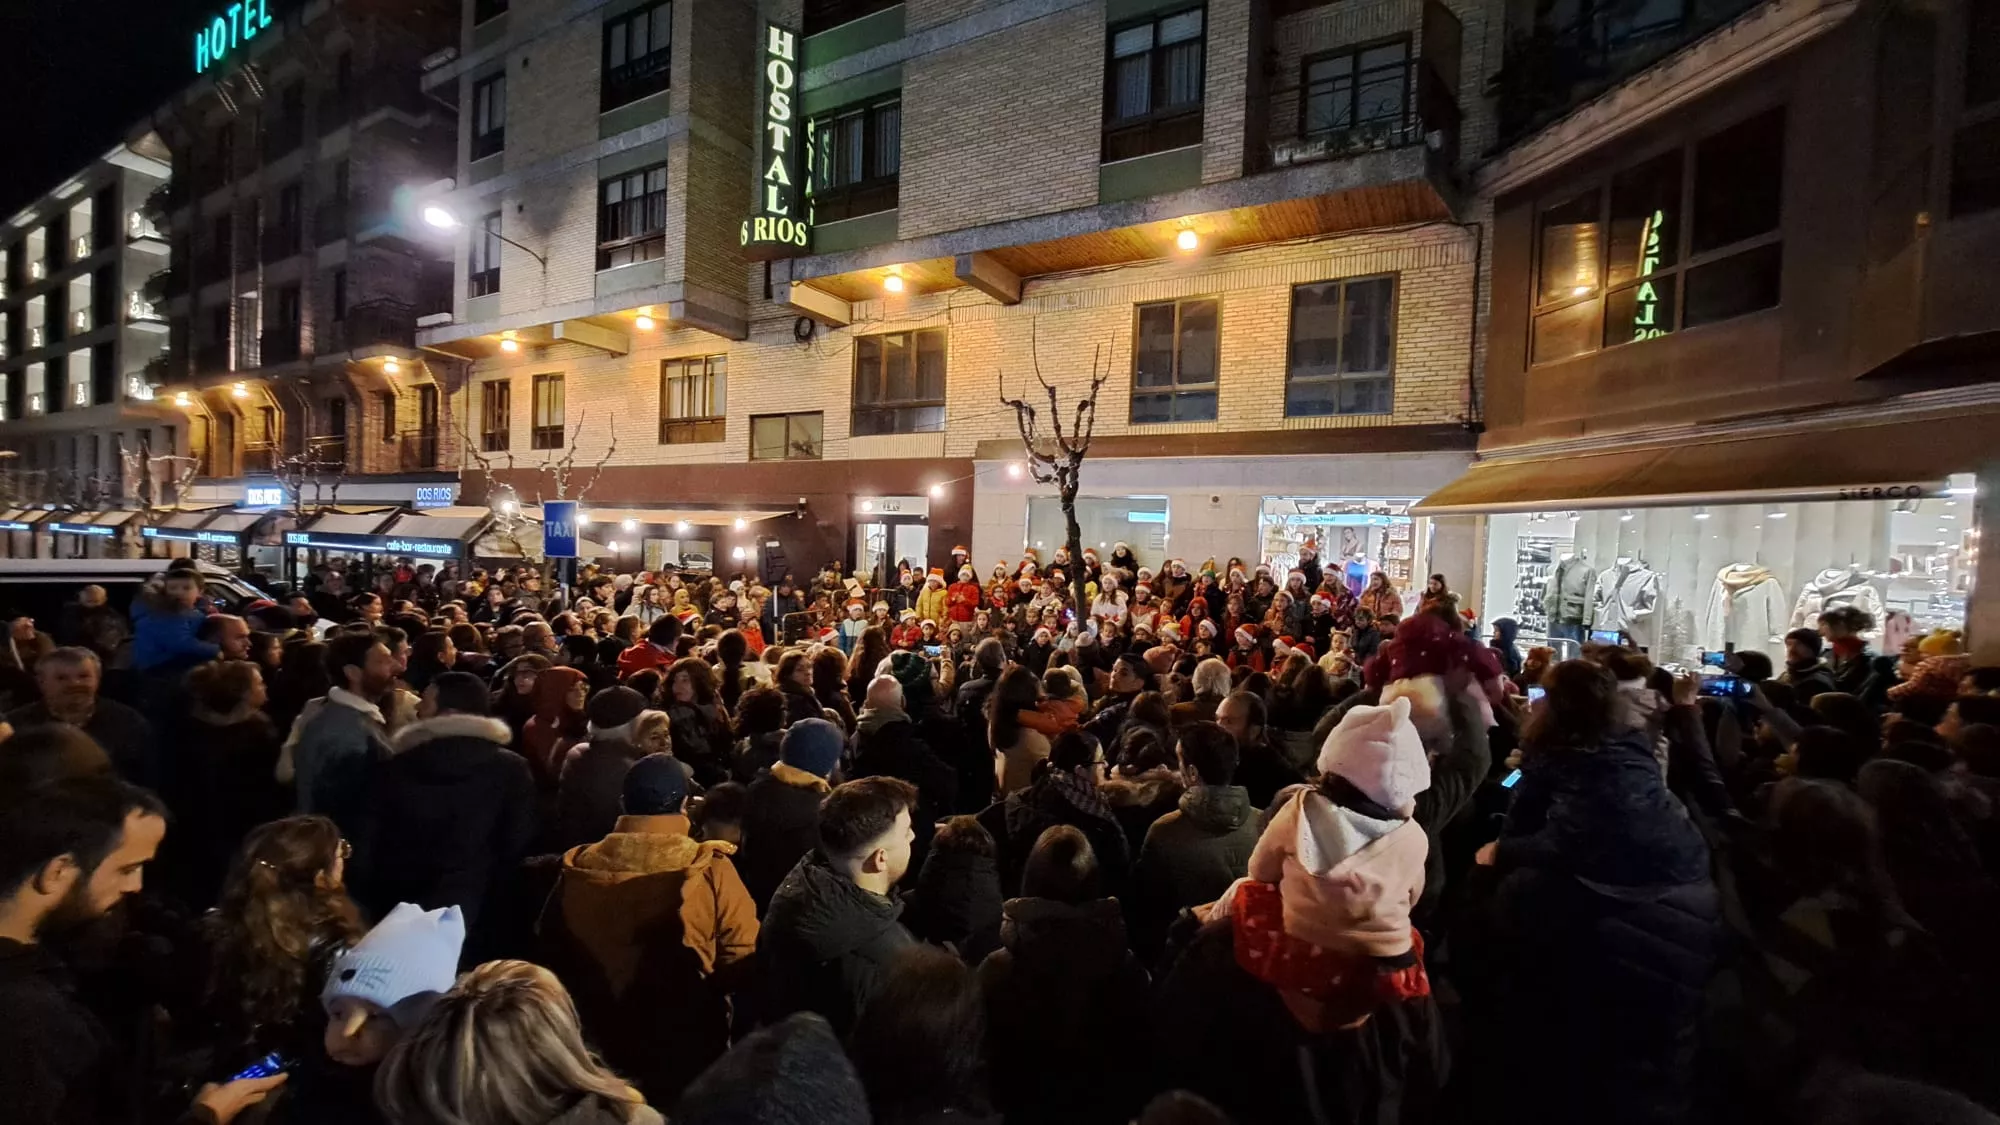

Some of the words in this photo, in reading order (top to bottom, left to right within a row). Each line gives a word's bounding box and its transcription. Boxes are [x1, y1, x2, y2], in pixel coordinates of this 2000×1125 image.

[197, 0, 272, 73] HOTEL
[764, 26, 794, 215] HOSTAL
[753, 217, 807, 246] RIOS
[416, 487, 432, 500] DOS
[433, 487, 452, 500] RIOS
[545, 520, 575, 537] TAXI
